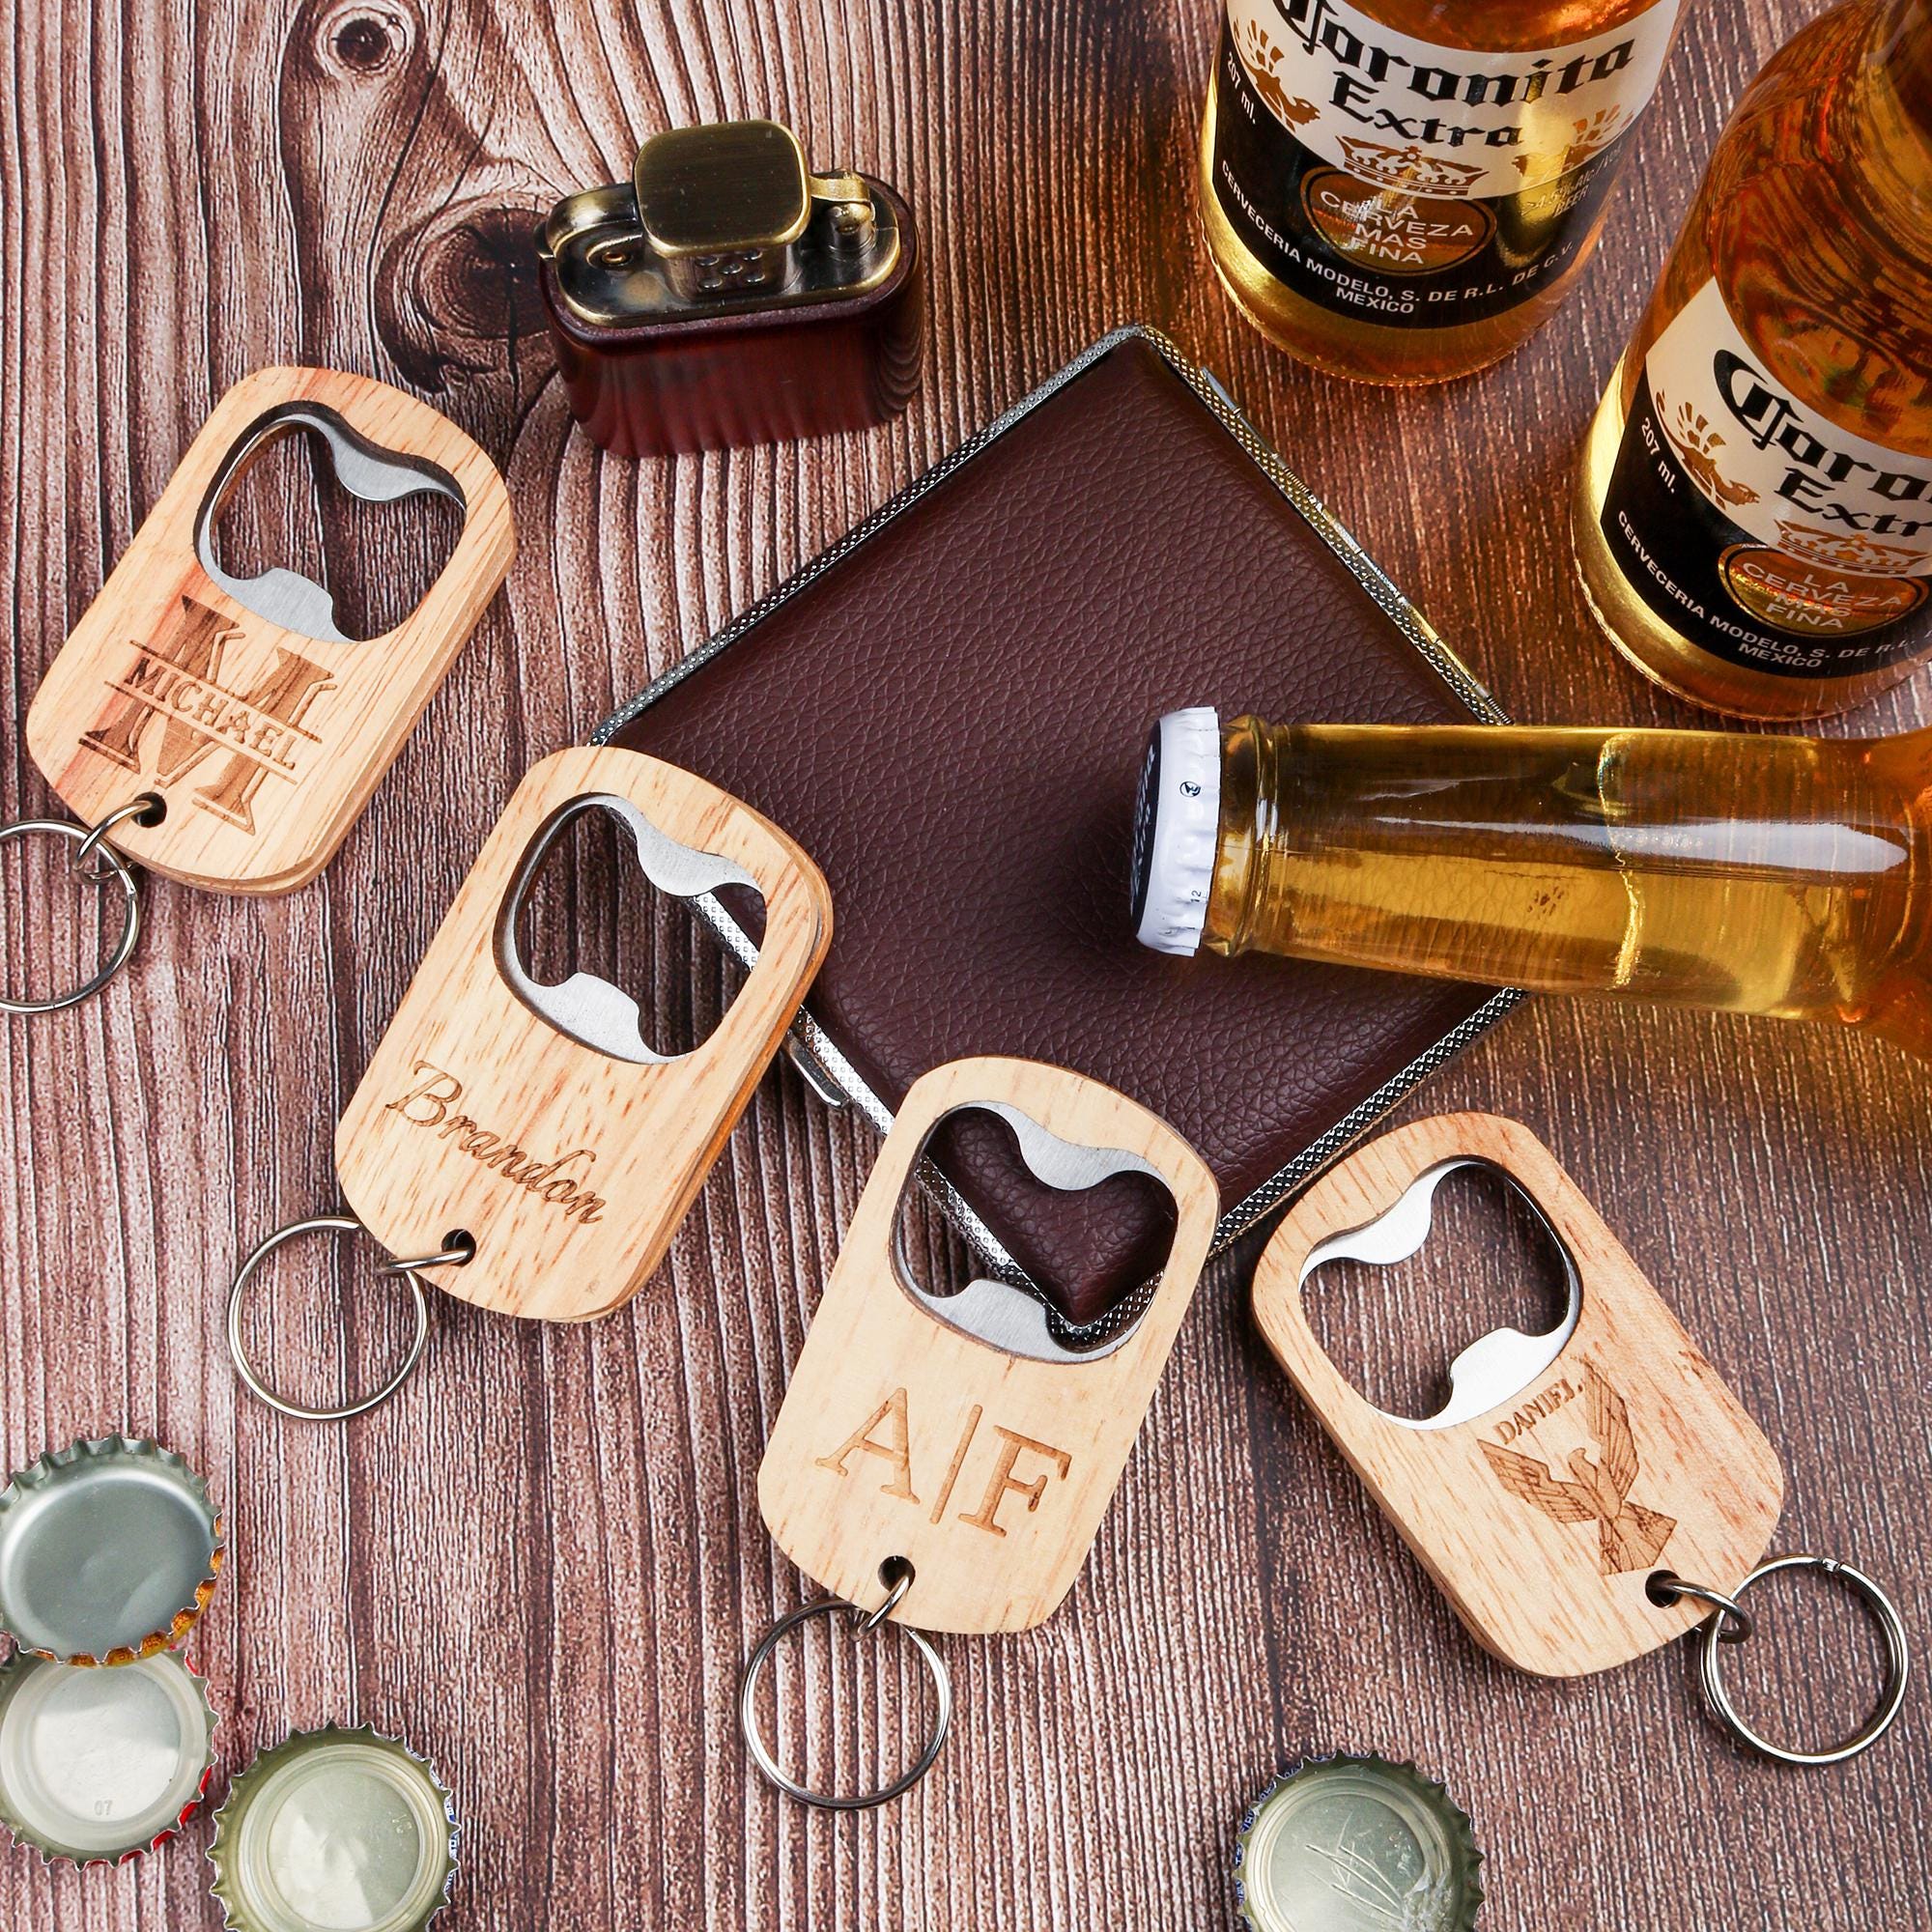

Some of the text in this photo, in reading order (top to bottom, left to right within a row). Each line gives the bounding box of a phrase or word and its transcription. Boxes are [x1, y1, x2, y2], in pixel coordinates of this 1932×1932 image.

[1227, 52, 1256, 125] 207 ml.
[1329, 71, 1524, 147] Extra
[1320, 190, 1474, 238] CERVEZA
[1377, 192, 1419, 219] LA
[1221, 159, 1301, 263] CERVECERIA
[1305, 257, 1393, 299] MODELO,
[1400, 289, 1421, 302] S.
[1428, 289, 1458, 302] DE
[1463, 283, 1504, 299] R.L.
[1512, 265, 1539, 286] DE
[1350, 236, 1425, 265] FINA
[1354, 223, 1428, 251] MAS
[1335, 287, 1415, 314] MEXICO
[1713, 349, 1932, 503] Coro
[1641, 416, 1676, 494] 207 ml.
[1618, 510, 1705, 619] CERVECERIA
[1709, 614, 1803, 658] MODELO,
[1809, 647, 1831, 659] S.
[1837, 647, 1870, 659] DE
[1742, 562, 1902, 607] CERVEZA
[1776, 592, 1853, 618] MAS
[1804, 573, 1849, 593] LA
[1766, 602, 1843, 629] FINA
[1738, 642, 1823, 668] MEXICO
[123, 657, 297, 771] MICHAEL
[385, 1060, 607, 1224] Brandon
[1492, 1378, 1583, 1445] DANIEL
